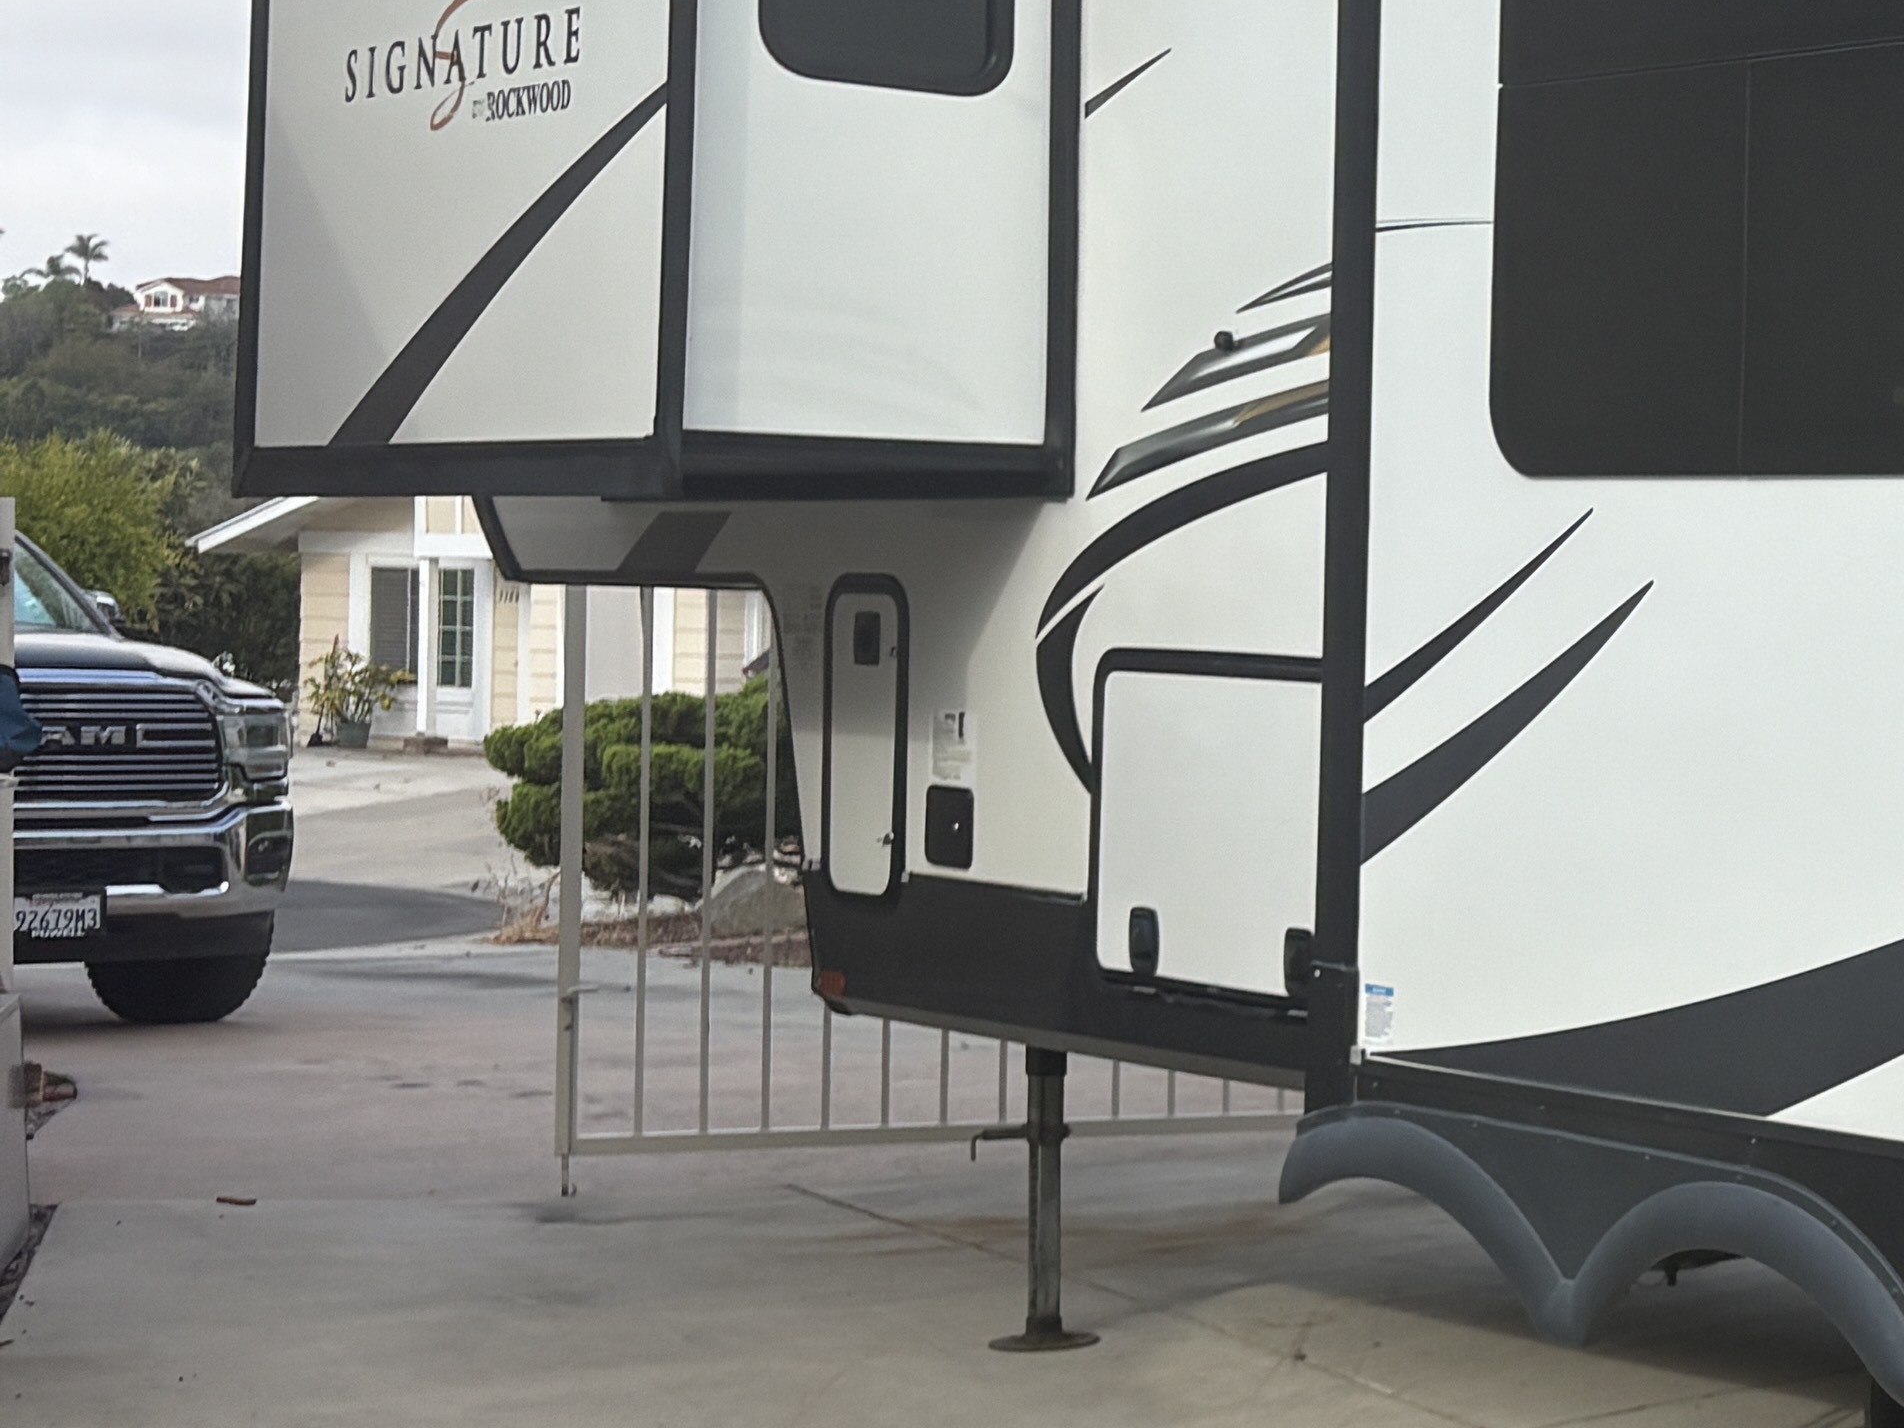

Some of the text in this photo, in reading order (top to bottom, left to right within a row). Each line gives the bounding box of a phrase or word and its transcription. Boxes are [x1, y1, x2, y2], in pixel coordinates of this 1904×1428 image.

[345, 5, 582, 104] SIGNATURE
[485, 79, 572, 122] ROCKWOOD
[39, 725, 127, 746] AM
